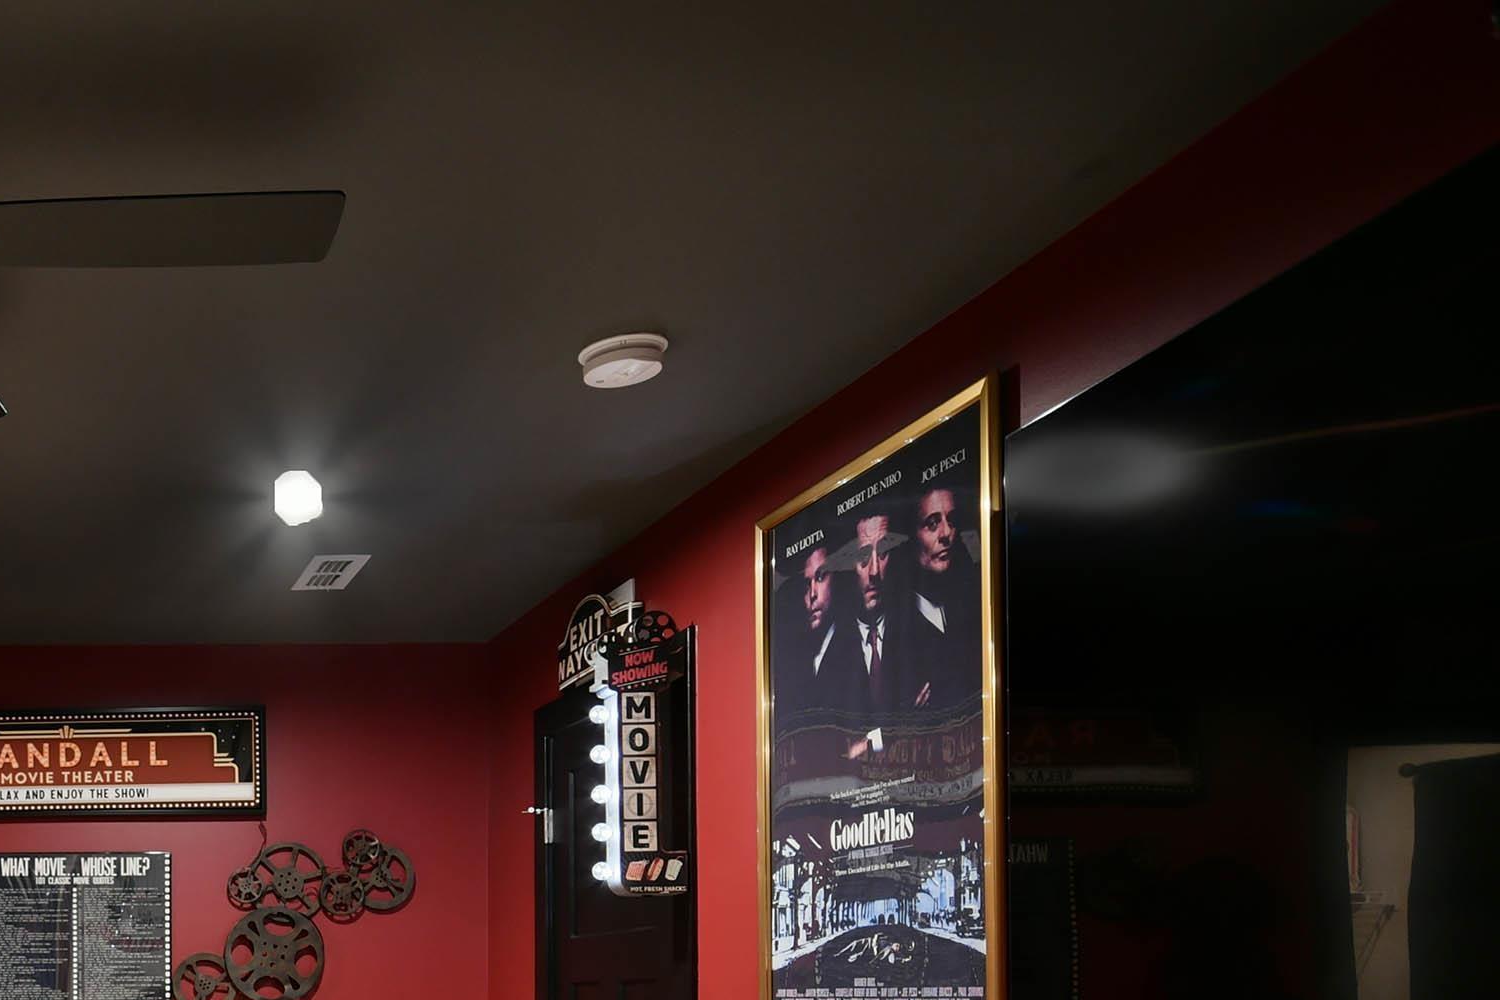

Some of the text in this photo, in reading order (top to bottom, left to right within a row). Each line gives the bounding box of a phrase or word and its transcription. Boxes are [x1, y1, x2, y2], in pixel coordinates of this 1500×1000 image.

[920, 448, 967, 484] JOE PESCI
[836, 469, 902, 516] ROBERT DE NIRO
[785, 529, 825, 558] RAY LIOTTA
[569, 608, 605, 652] EXIT
[624, 649, 655, 668] NOW
[611, 661, 668, 686] SHOWING
[0, 769, 134, 785] MOVIE THEATER
[625, 695, 651, 850] MOVIE
[24, 787, 45, 800] AND
[50, 787, 83, 800] ENJOY
[89, 786, 109, 799] THE
[115, 786, 150, 799] SHOW!
[0, 857, 30, 878] WHAT
[120, 856, 151, 877] LINE?
